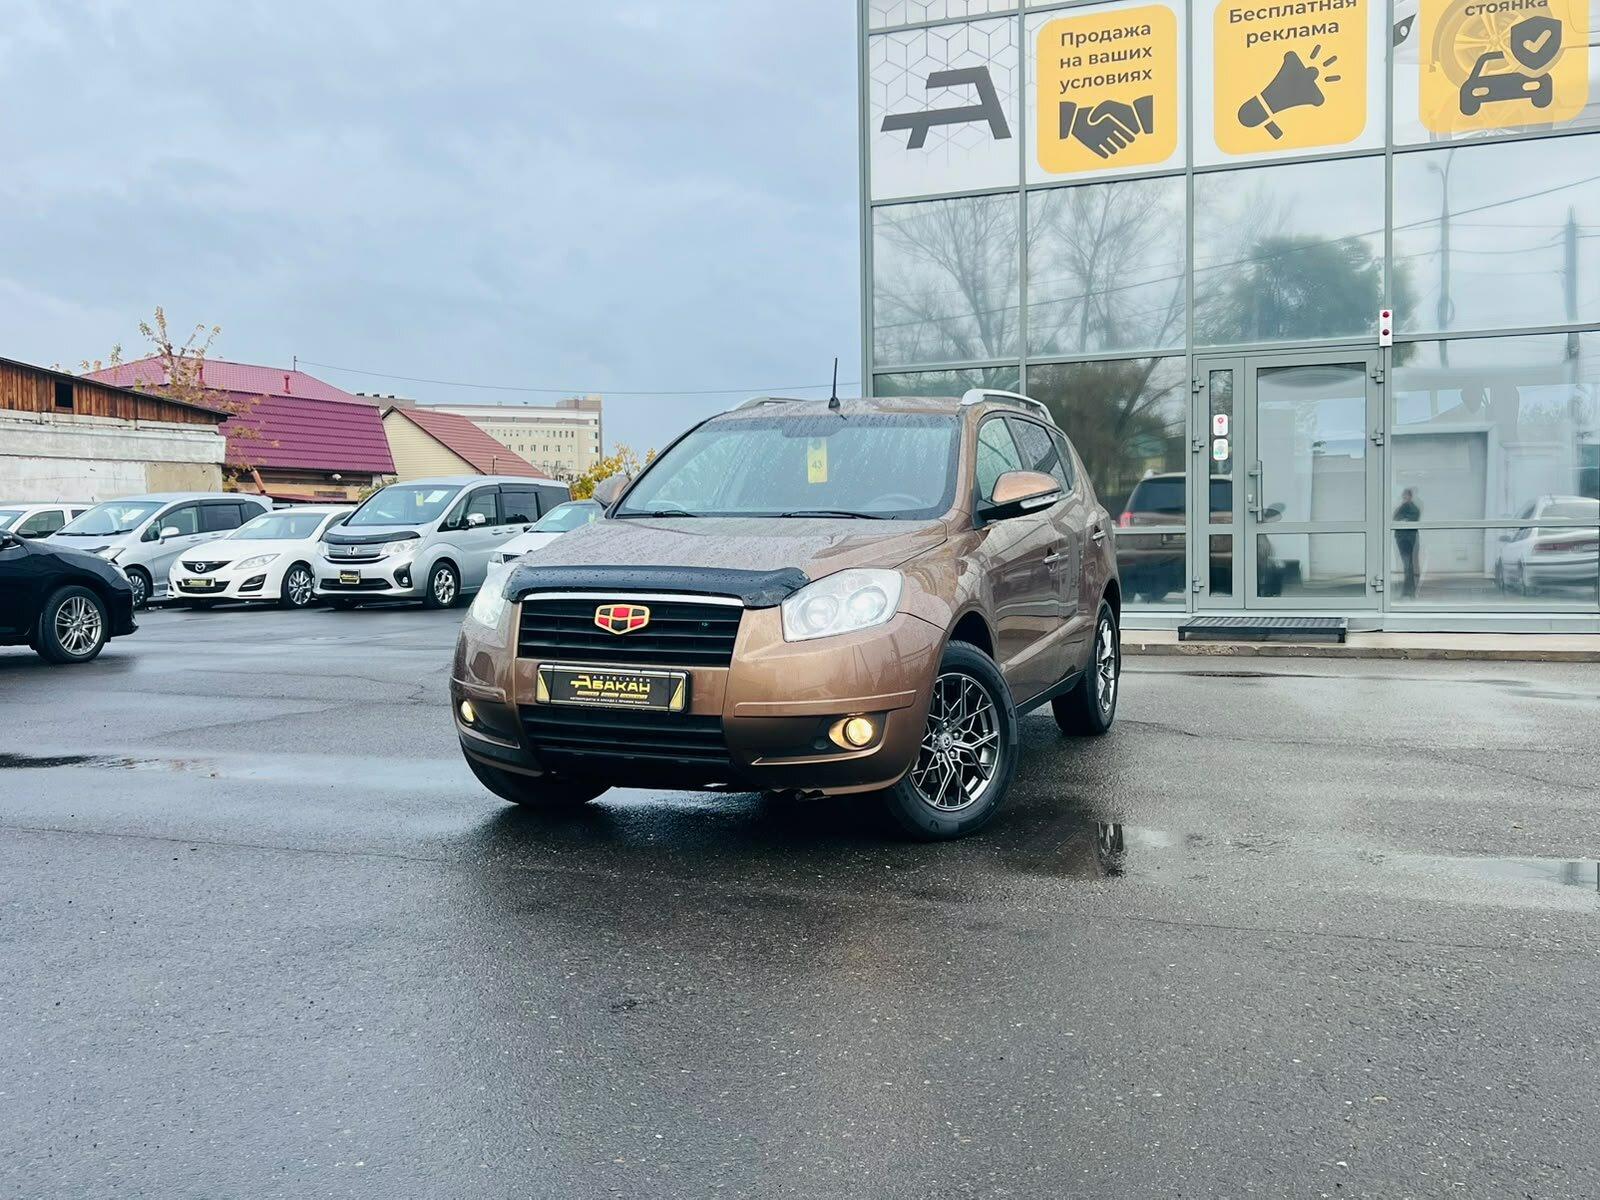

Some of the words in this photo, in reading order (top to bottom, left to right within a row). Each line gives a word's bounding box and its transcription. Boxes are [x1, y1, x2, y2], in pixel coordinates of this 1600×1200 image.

[1229, 0, 1357, 23] Бесплатная
[1464, 0, 1548, 16] стоянка
[1061, 24, 1151, 48] Продажа
[1246, 21, 1339, 48] реклама
[1060, 56, 1082, 69] на
[1088, 46, 1153, 65] ваших
[1059, 69, 1152, 94] условиях
